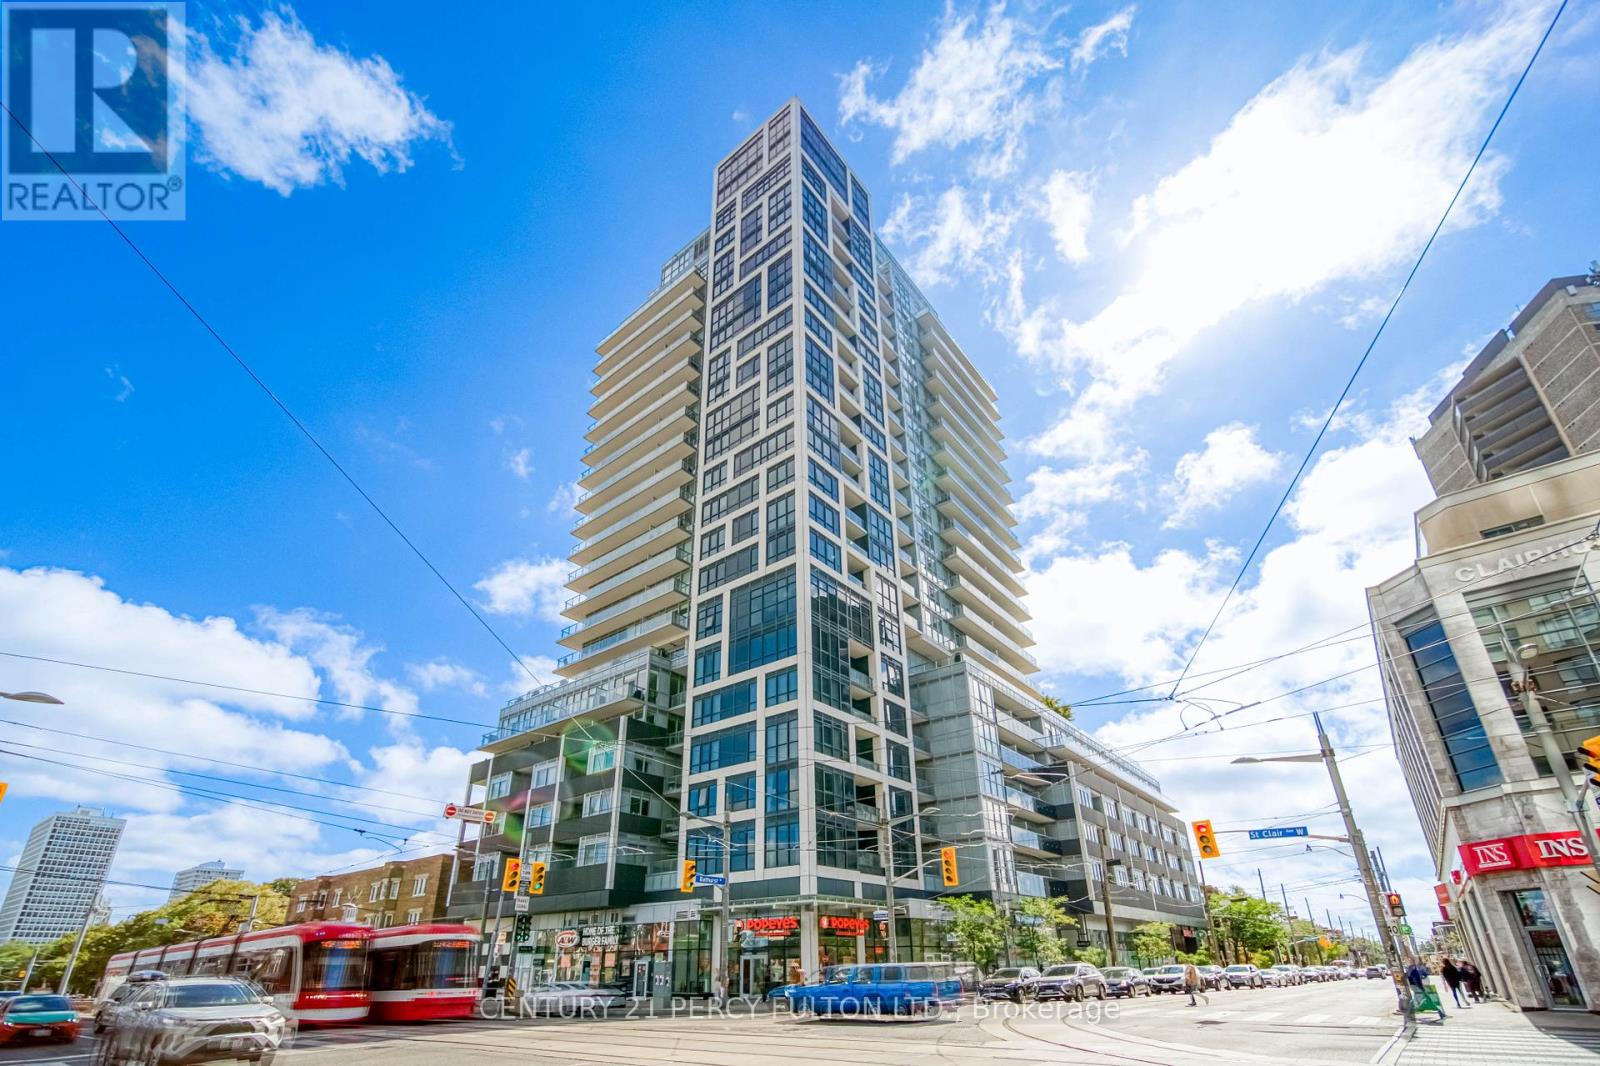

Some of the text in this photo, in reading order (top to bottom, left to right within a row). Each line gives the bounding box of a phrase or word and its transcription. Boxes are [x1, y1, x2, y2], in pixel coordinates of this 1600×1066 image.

[1250, 830, 1260, 839] St
[1262, 829, 1283, 838] Clair
[1296, 827, 1304, 836] W
[1534, 838, 1589, 859] INS
[747, 917, 798, 930] POPEYES
[830, 916, 870, 930] POPEYES
[583, 927, 597, 936] HOME
